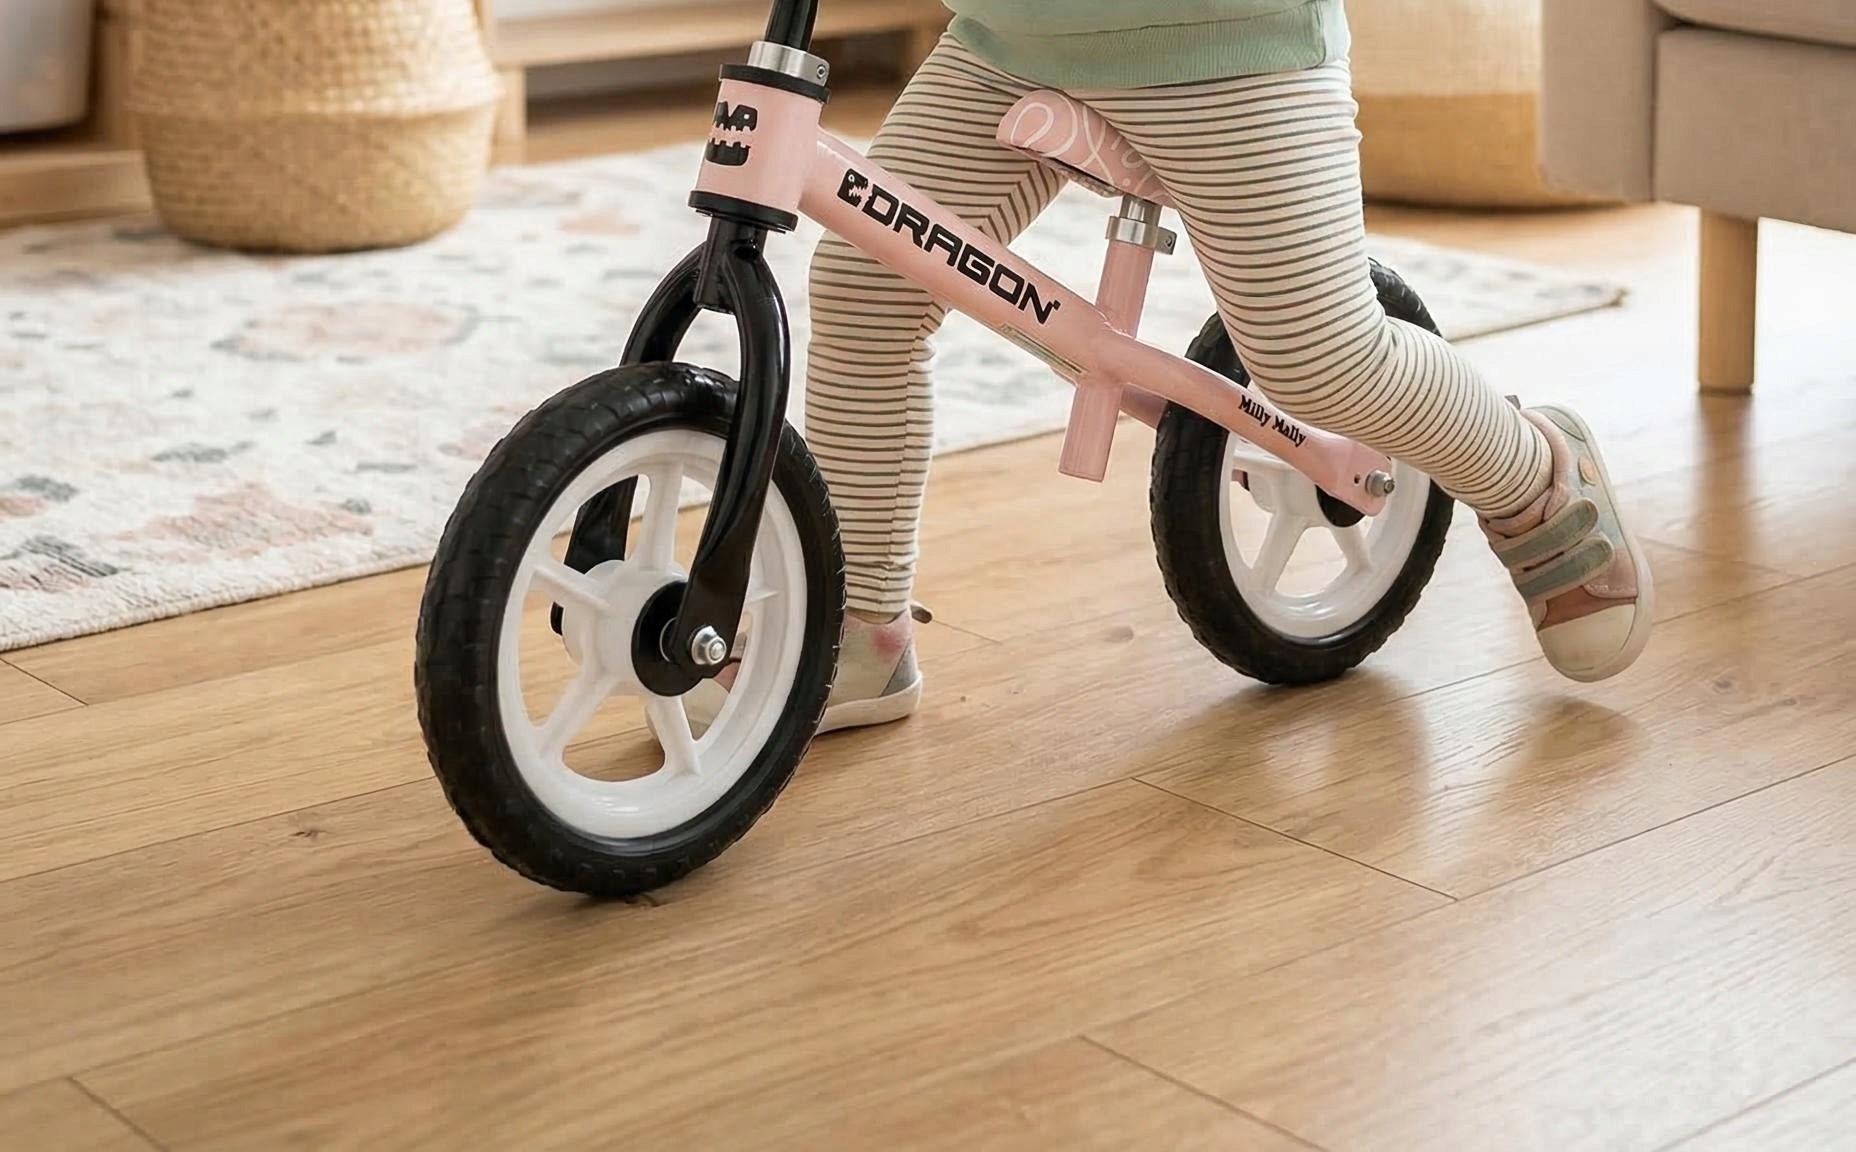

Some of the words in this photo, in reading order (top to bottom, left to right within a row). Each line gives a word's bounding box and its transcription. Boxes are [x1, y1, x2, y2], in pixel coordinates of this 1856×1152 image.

[862, 184, 1061, 325] DRAGON
[1238, 394, 1271, 427] Milly
[1272, 415, 1306, 448] Mally
